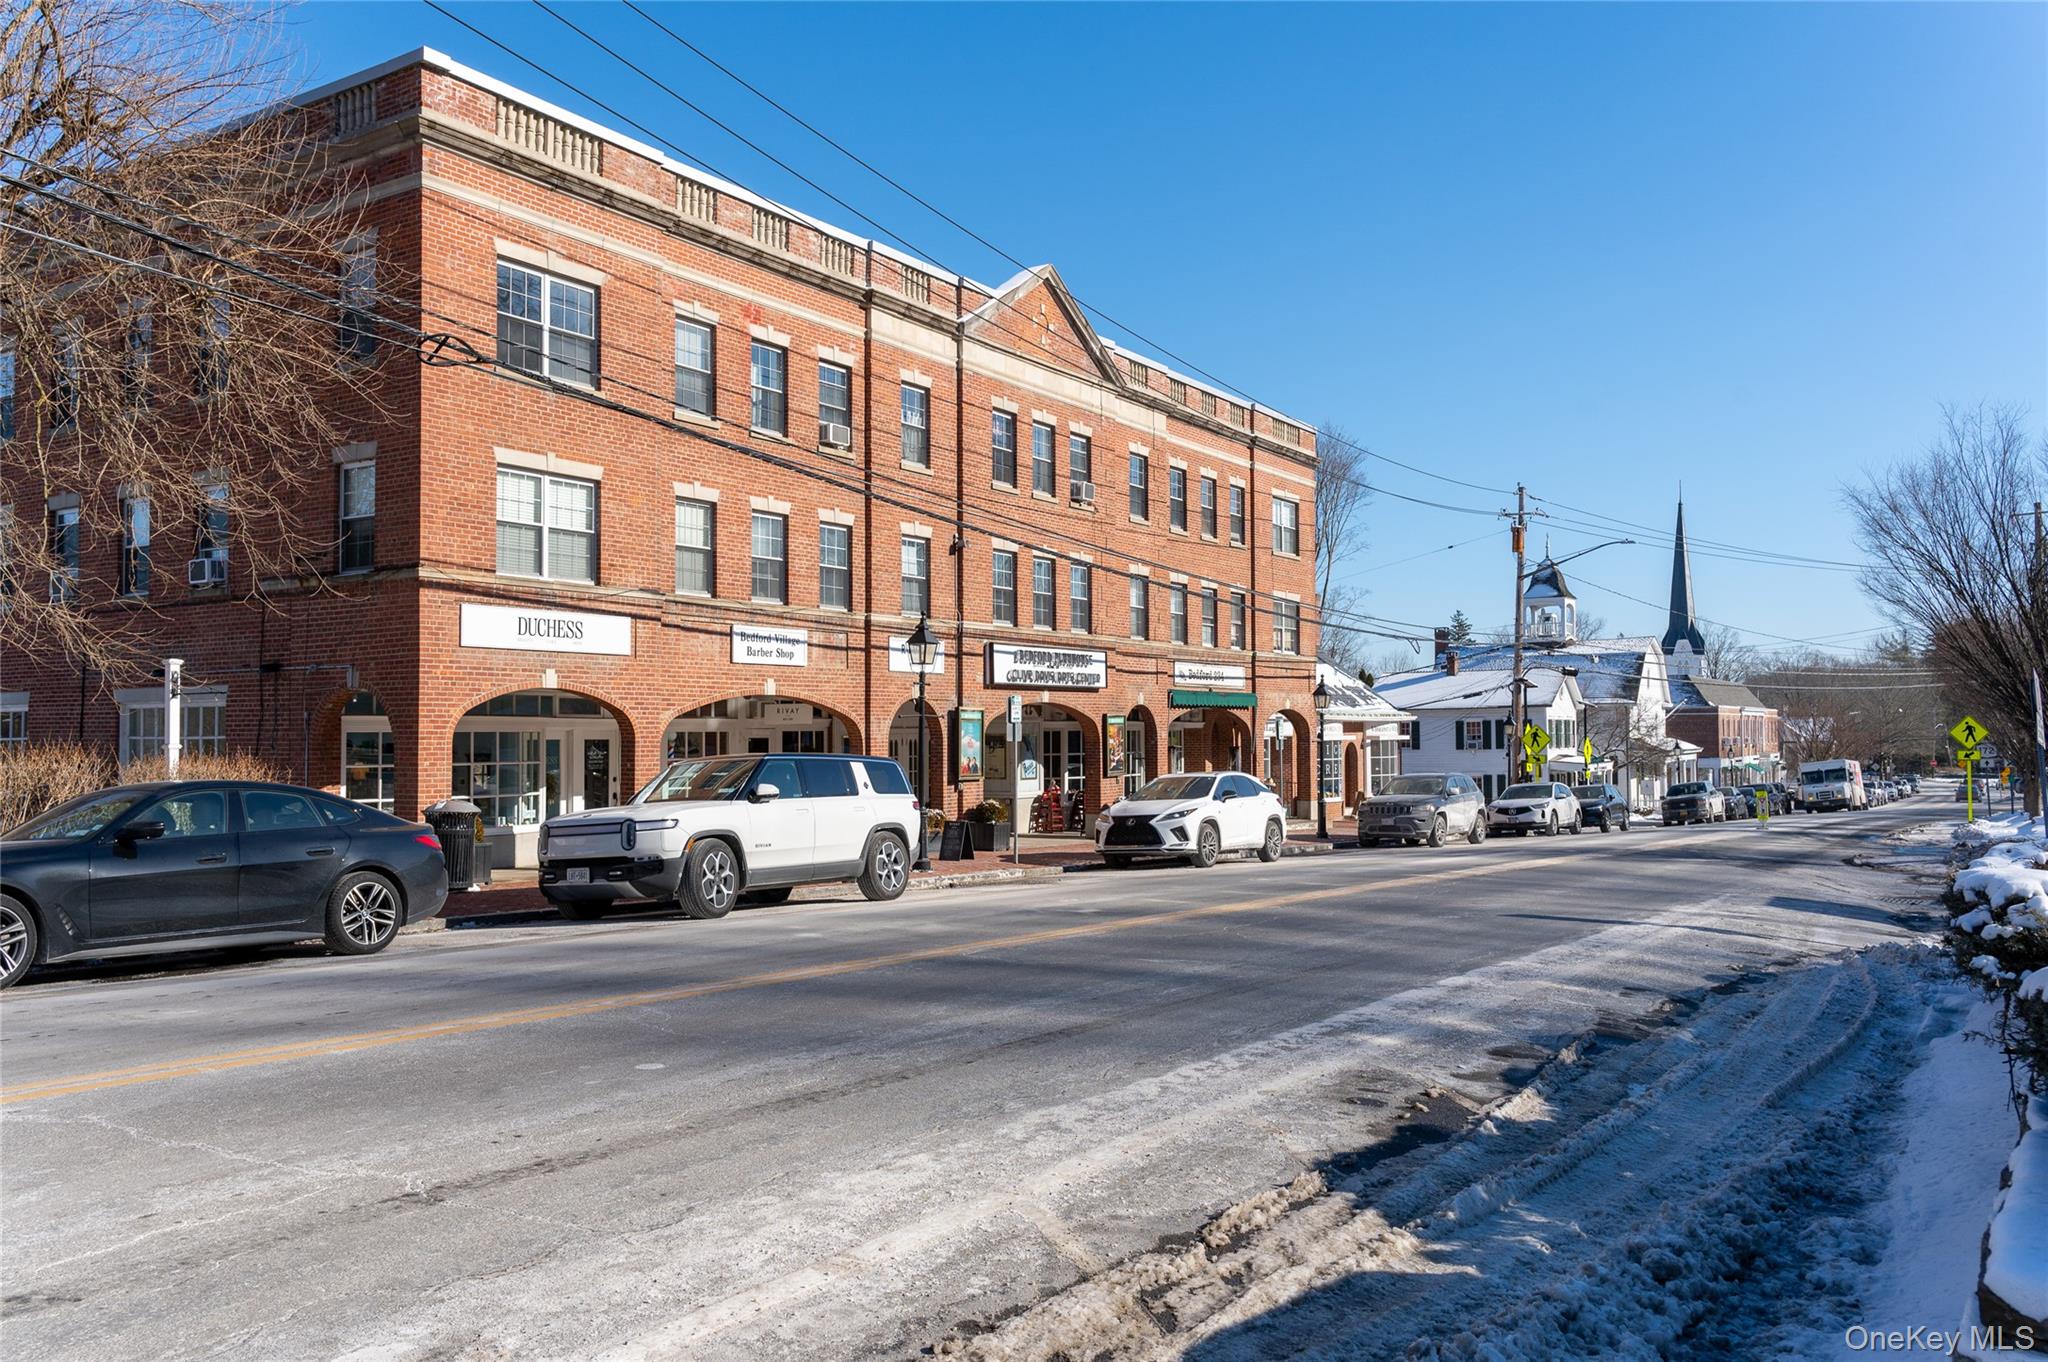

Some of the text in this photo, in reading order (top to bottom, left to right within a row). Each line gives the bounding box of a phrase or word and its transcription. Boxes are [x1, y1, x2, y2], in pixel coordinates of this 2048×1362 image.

[518, 616, 583, 639] DUCHESS
[740, 631, 801, 646] Bedford Village
[746, 646, 795, 660] Barber Shop
